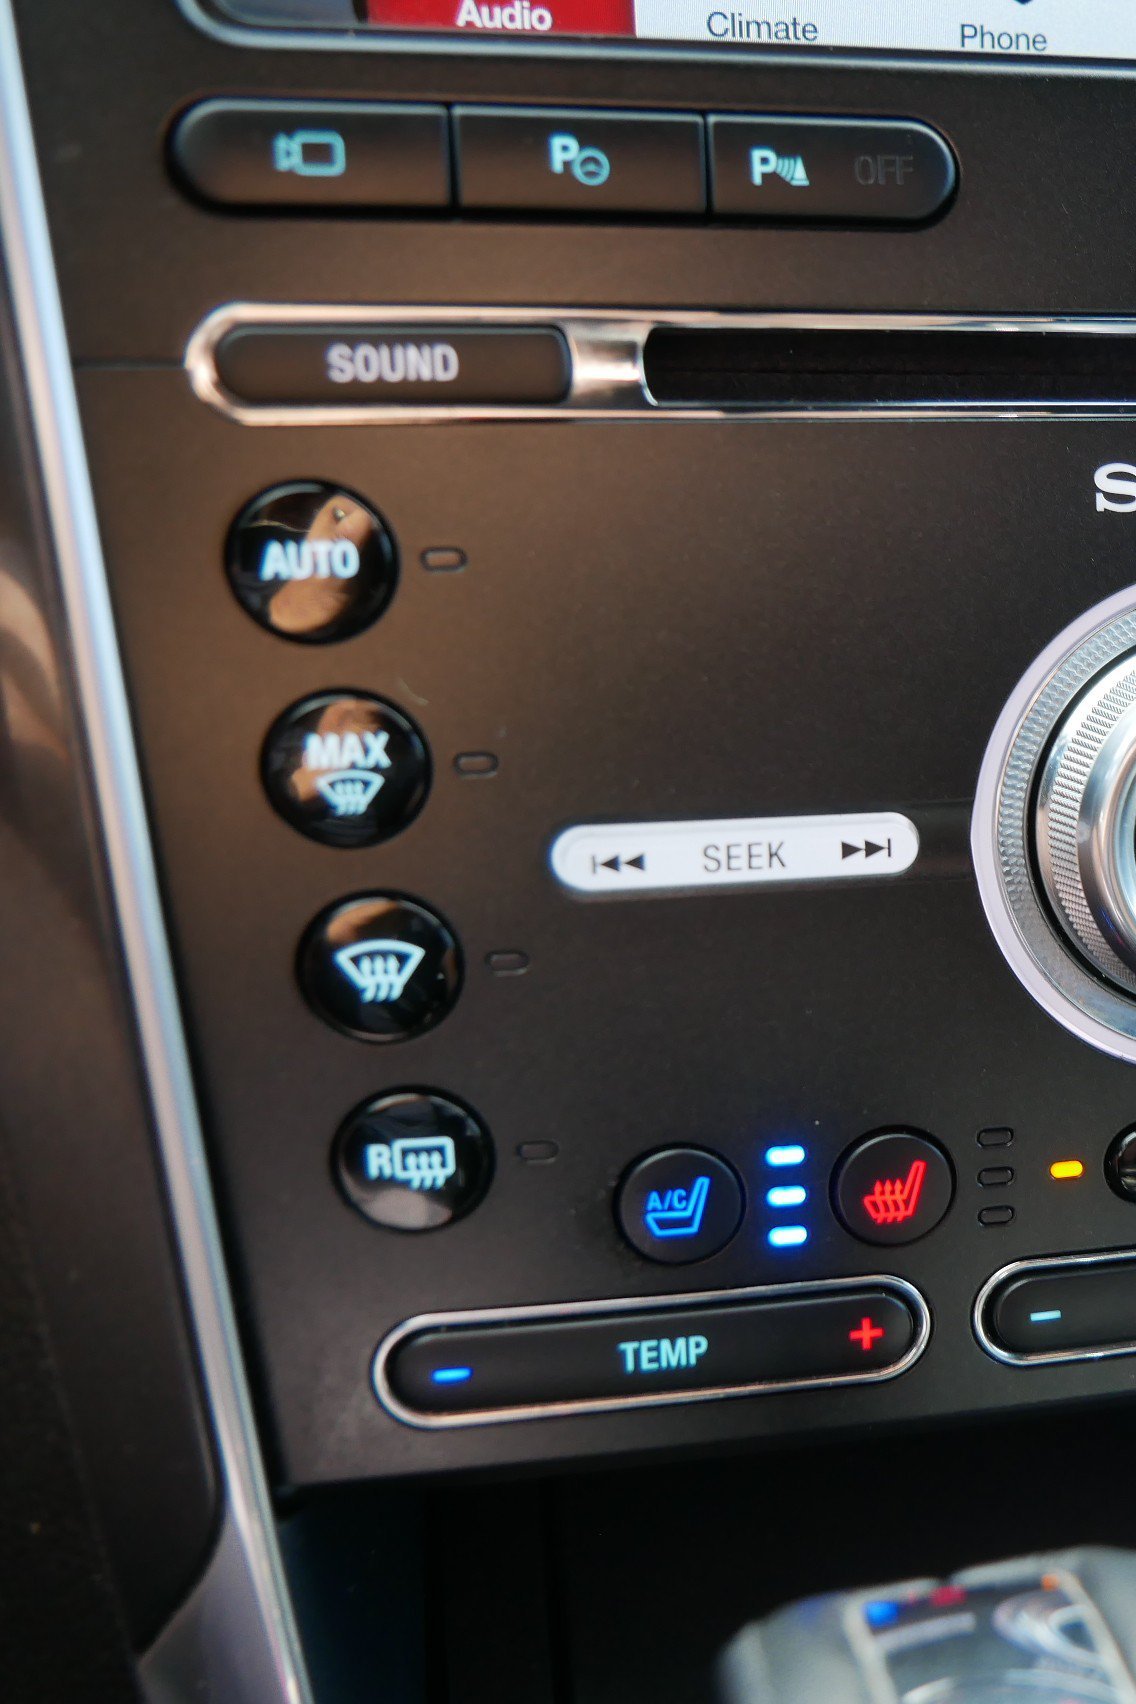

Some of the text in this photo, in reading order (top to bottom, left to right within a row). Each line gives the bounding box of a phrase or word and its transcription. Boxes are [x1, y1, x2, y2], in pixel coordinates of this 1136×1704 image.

[456, 0, 553, 31] Audio
[706, 10, 819, 42] Climate
[960, 23, 1047, 54] Phone
[853, 154, 916, 186] OFF
[326, 344, 461, 384] SOUND
[260, 540, 361, 582] AUTO
[304, 732, 392, 770] MAX
[702, 841, 787, 872] SEEK
[646, 1188, 688, 1213] A/C
[617, 1336, 709, 1373] TEMP
